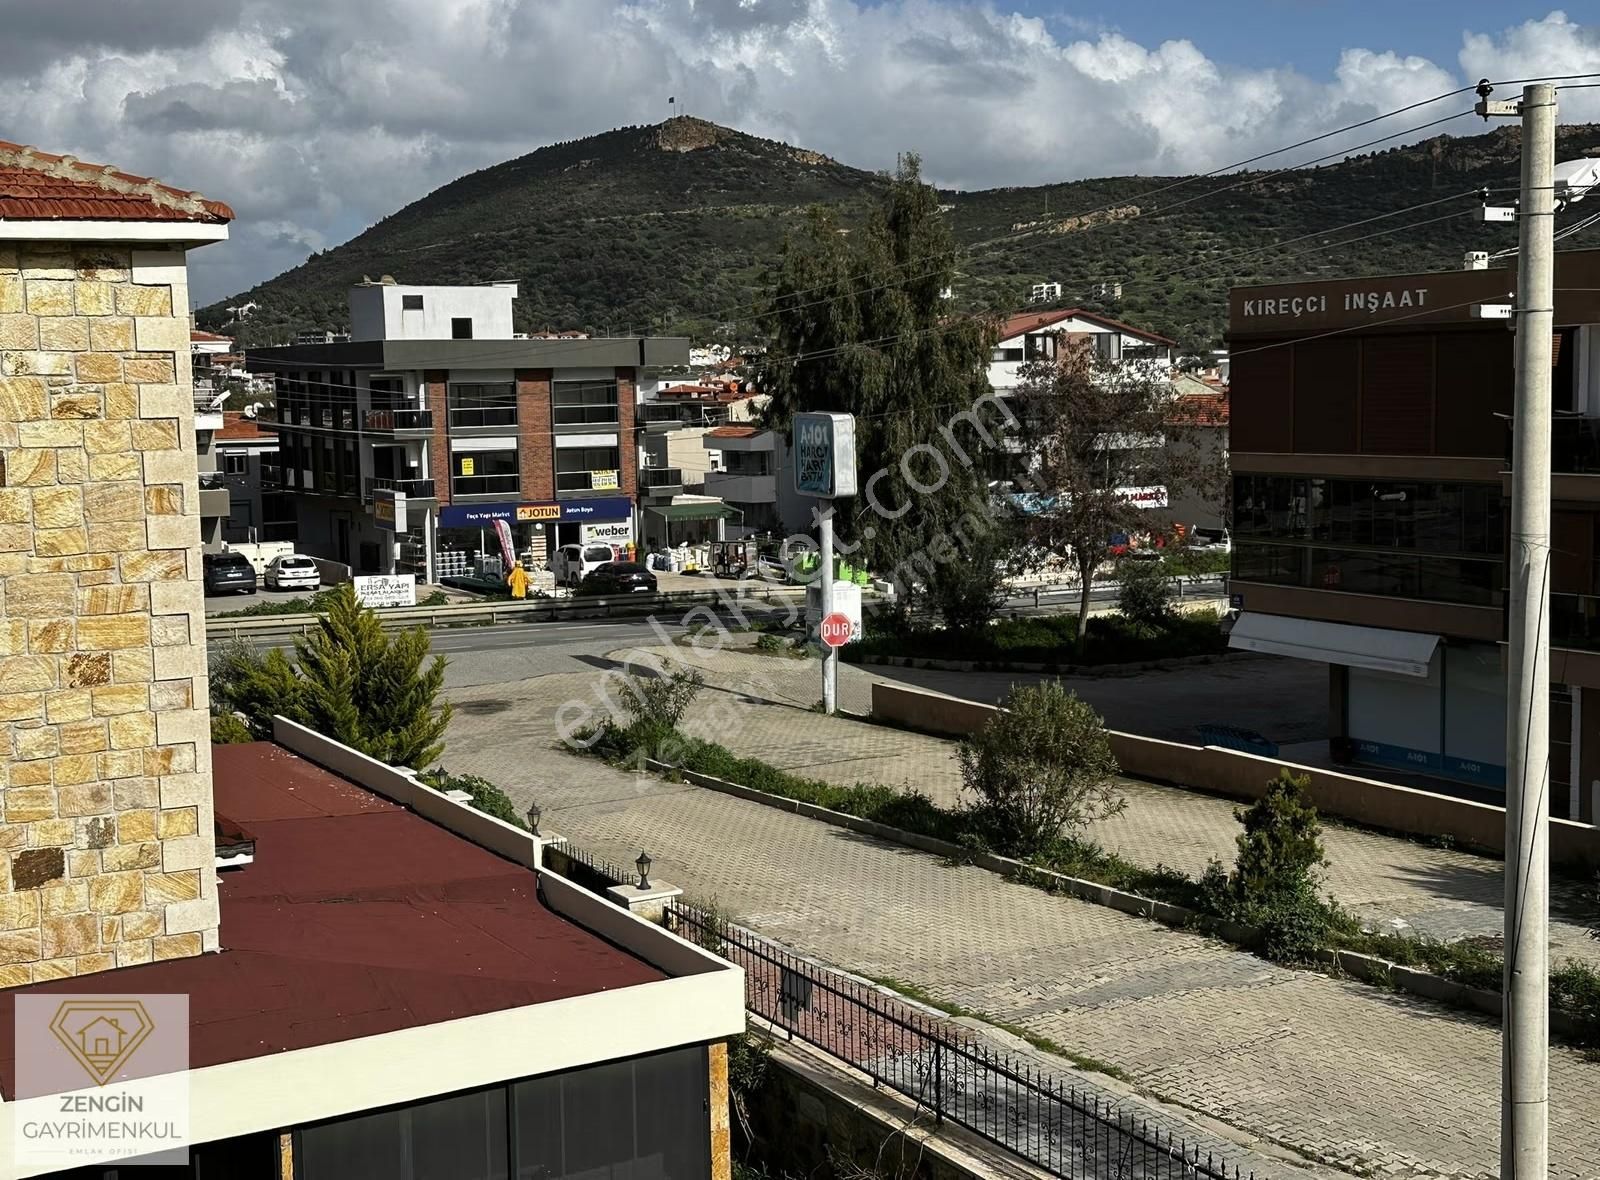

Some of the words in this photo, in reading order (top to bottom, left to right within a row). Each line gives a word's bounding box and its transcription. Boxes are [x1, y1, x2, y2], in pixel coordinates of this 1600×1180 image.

[528, 507, 559, 518] JOTUN
[595, 525, 629, 536] weber
[823, 623, 849, 637] DUR
